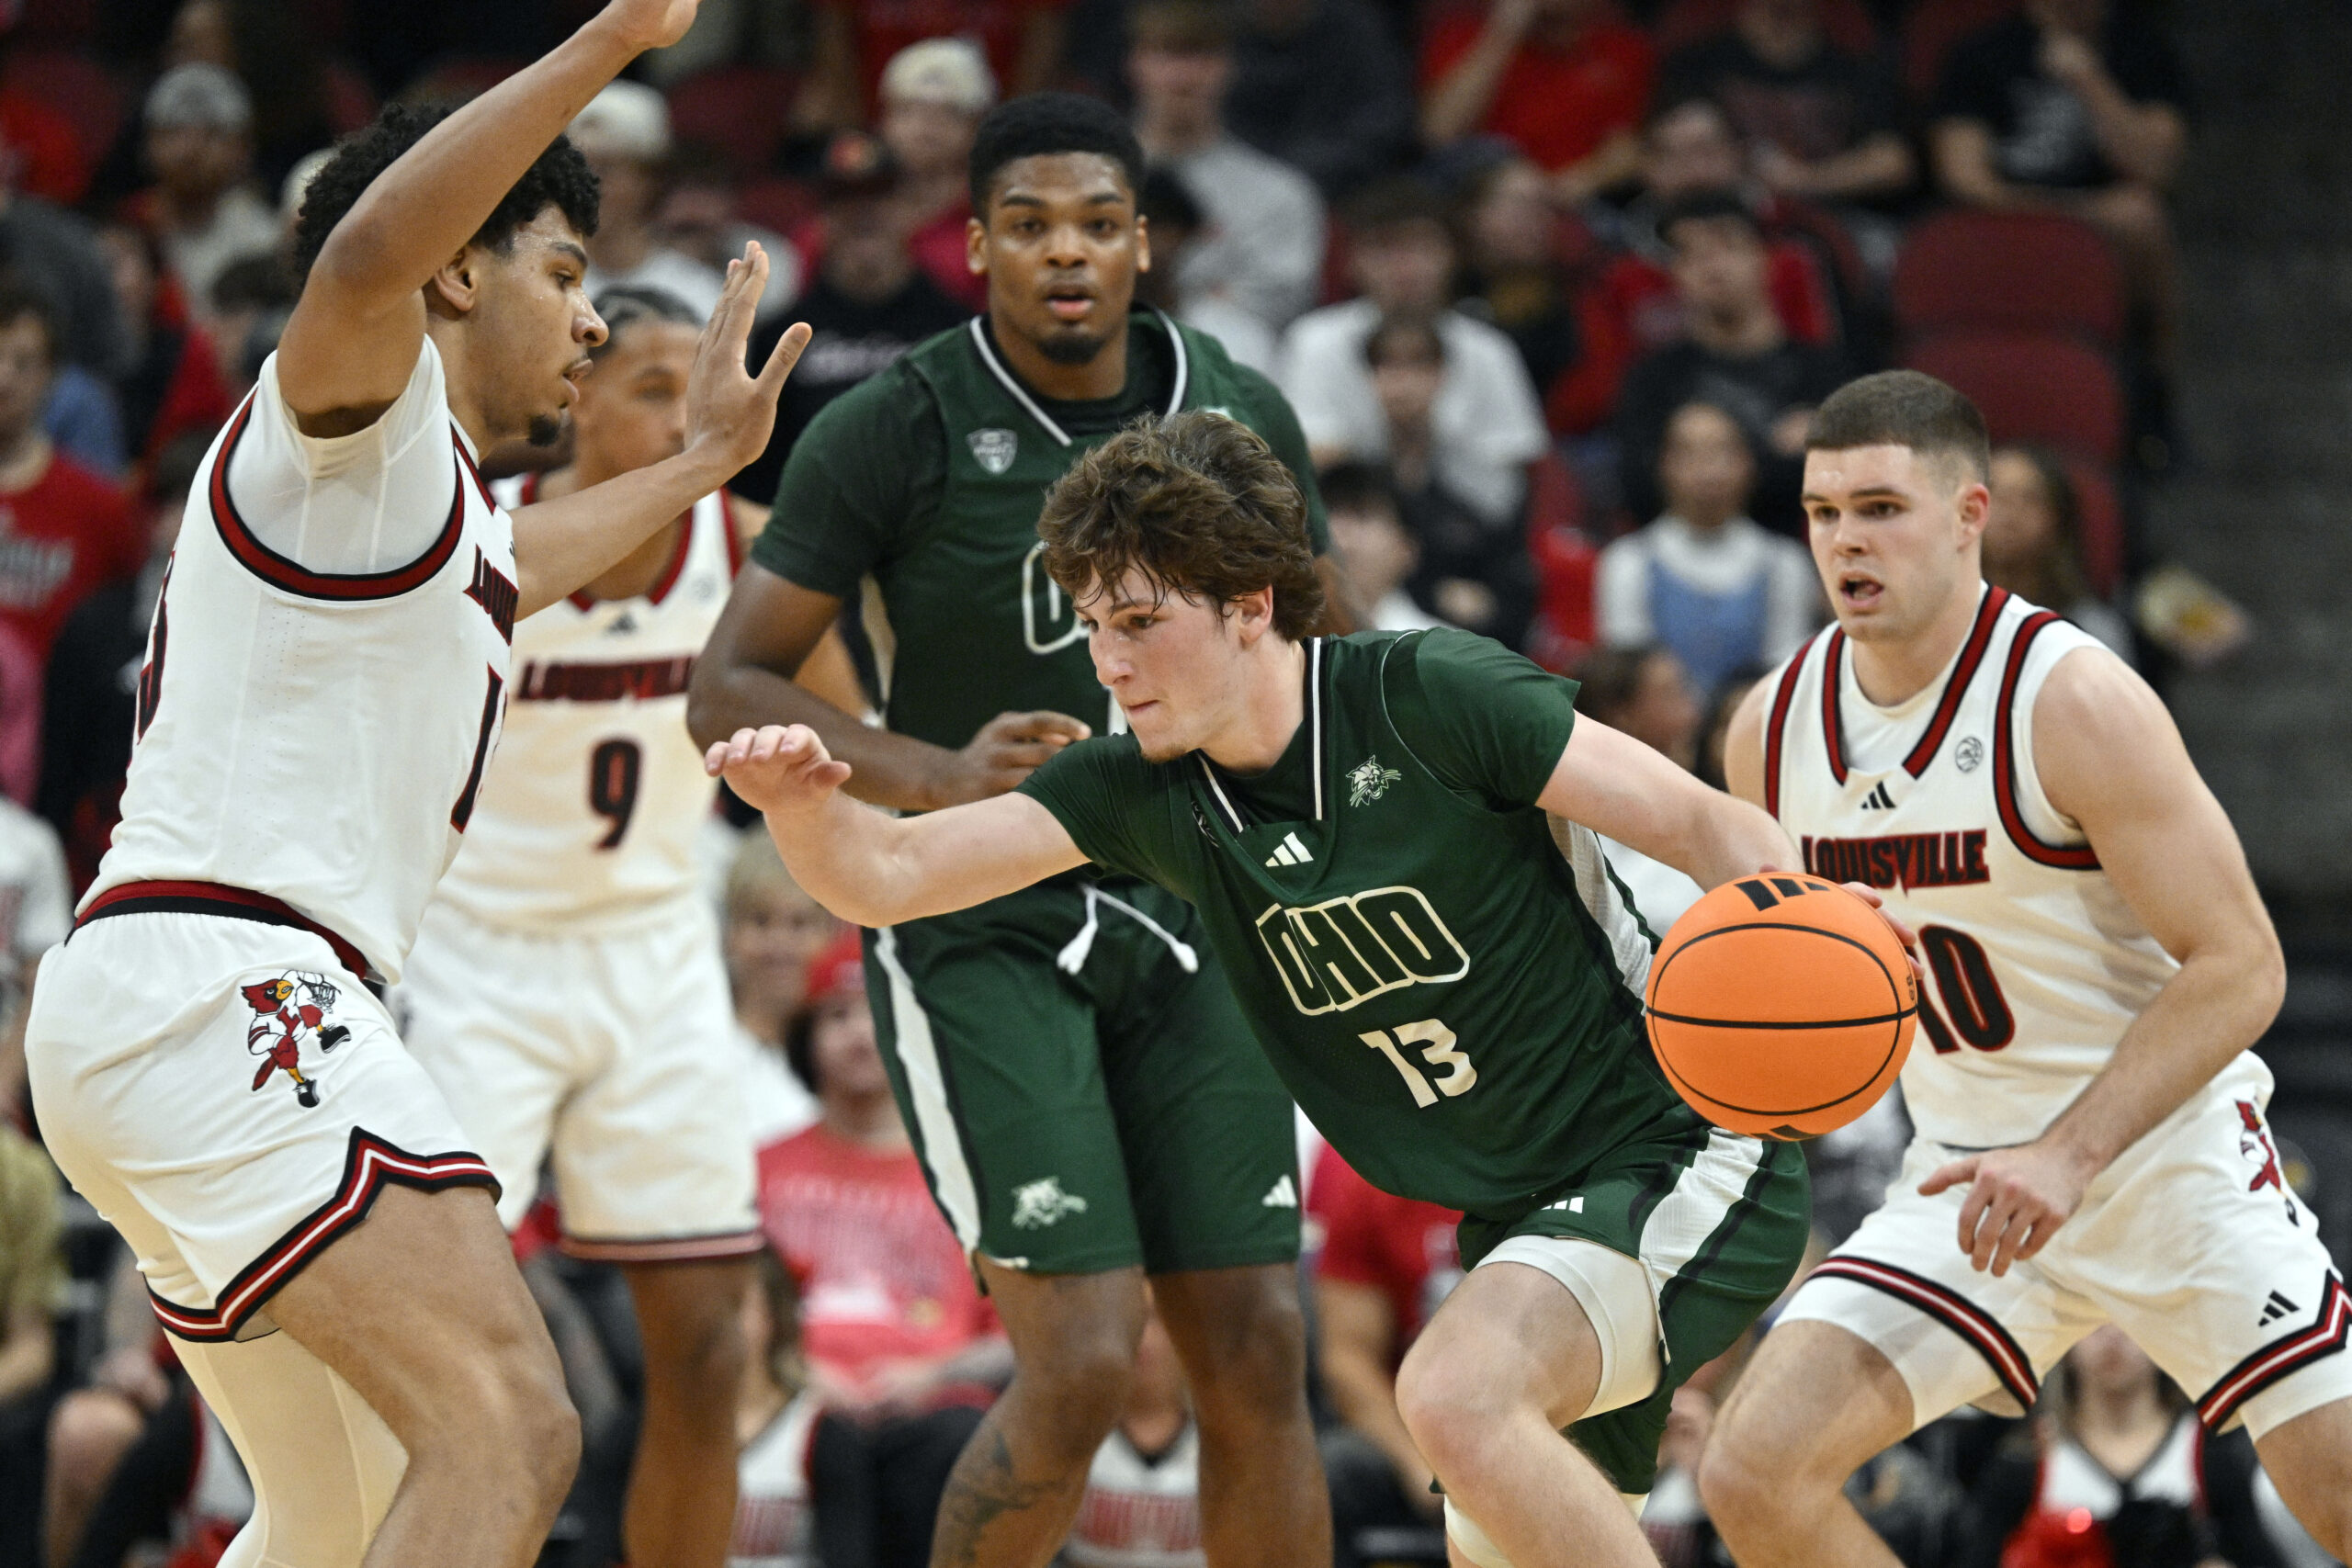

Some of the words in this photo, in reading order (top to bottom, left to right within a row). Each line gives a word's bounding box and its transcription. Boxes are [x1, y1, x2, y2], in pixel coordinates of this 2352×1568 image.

[516, 653, 696, 705] LOUISVILL
[590, 738, 642, 850] 9
[1802, 829, 1991, 897] LOUISVILLE
[1255, 886, 1471, 1016] OHIO
[1358, 1018, 1478, 1109] 13
